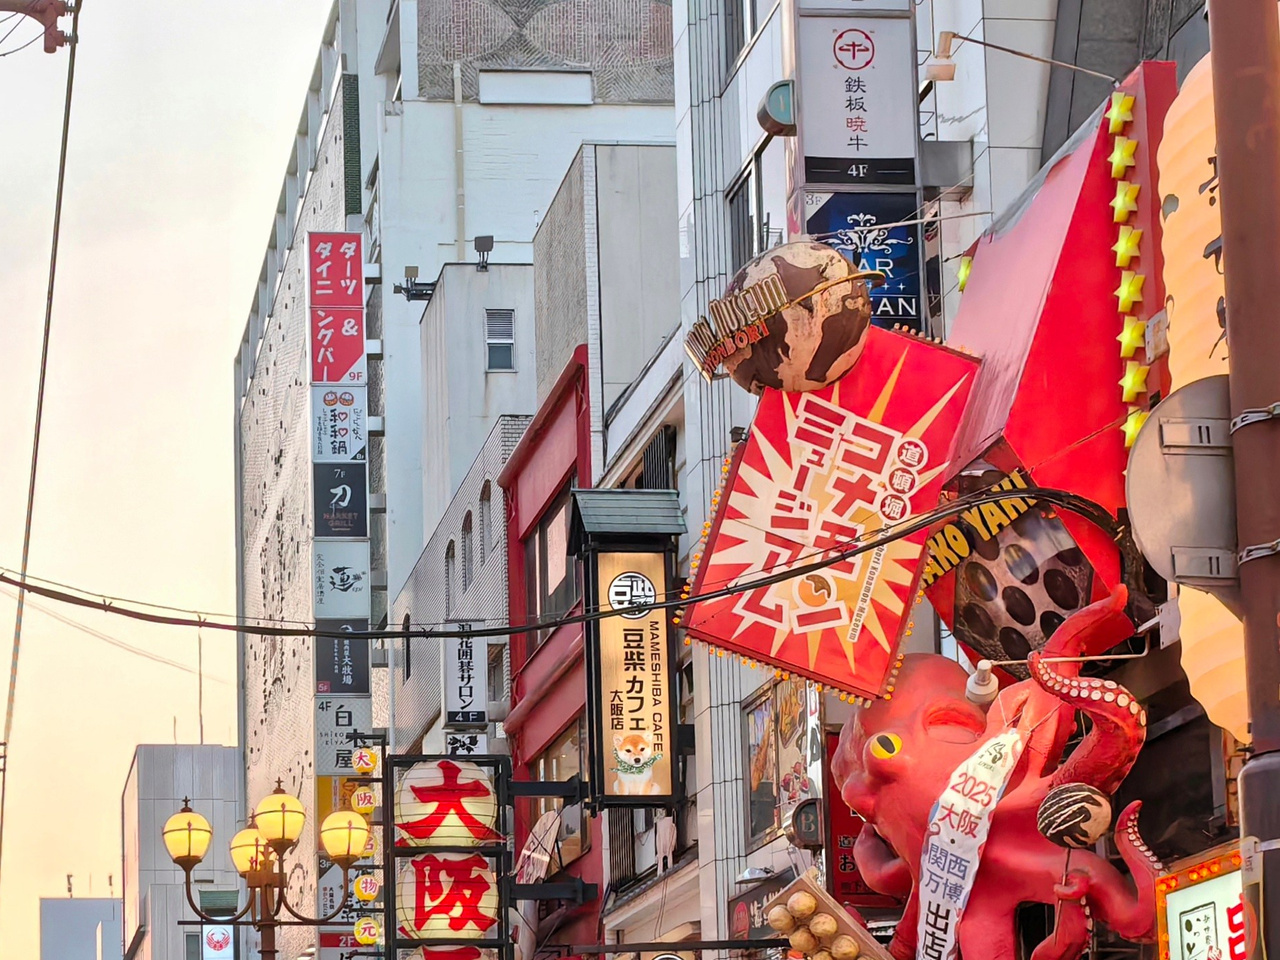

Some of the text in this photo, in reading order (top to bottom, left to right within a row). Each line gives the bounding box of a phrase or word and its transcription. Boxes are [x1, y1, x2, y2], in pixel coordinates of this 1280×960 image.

[847, 163, 869, 178] 4F
[858, 258, 894, 279] AR
[881, 440, 925, 522] 道頓堀
[622, 627, 647, 731] 豆柴カフェ
[648, 620, 664, 752] MAMESHIBA CAFE
[318, 701, 331, 711] 4F
[609, 689, 624, 731] 大阪店
[950, 772, 996, 807] 2025
[928, 842, 971, 881] 関西
[924, 869, 966, 903] 万博
